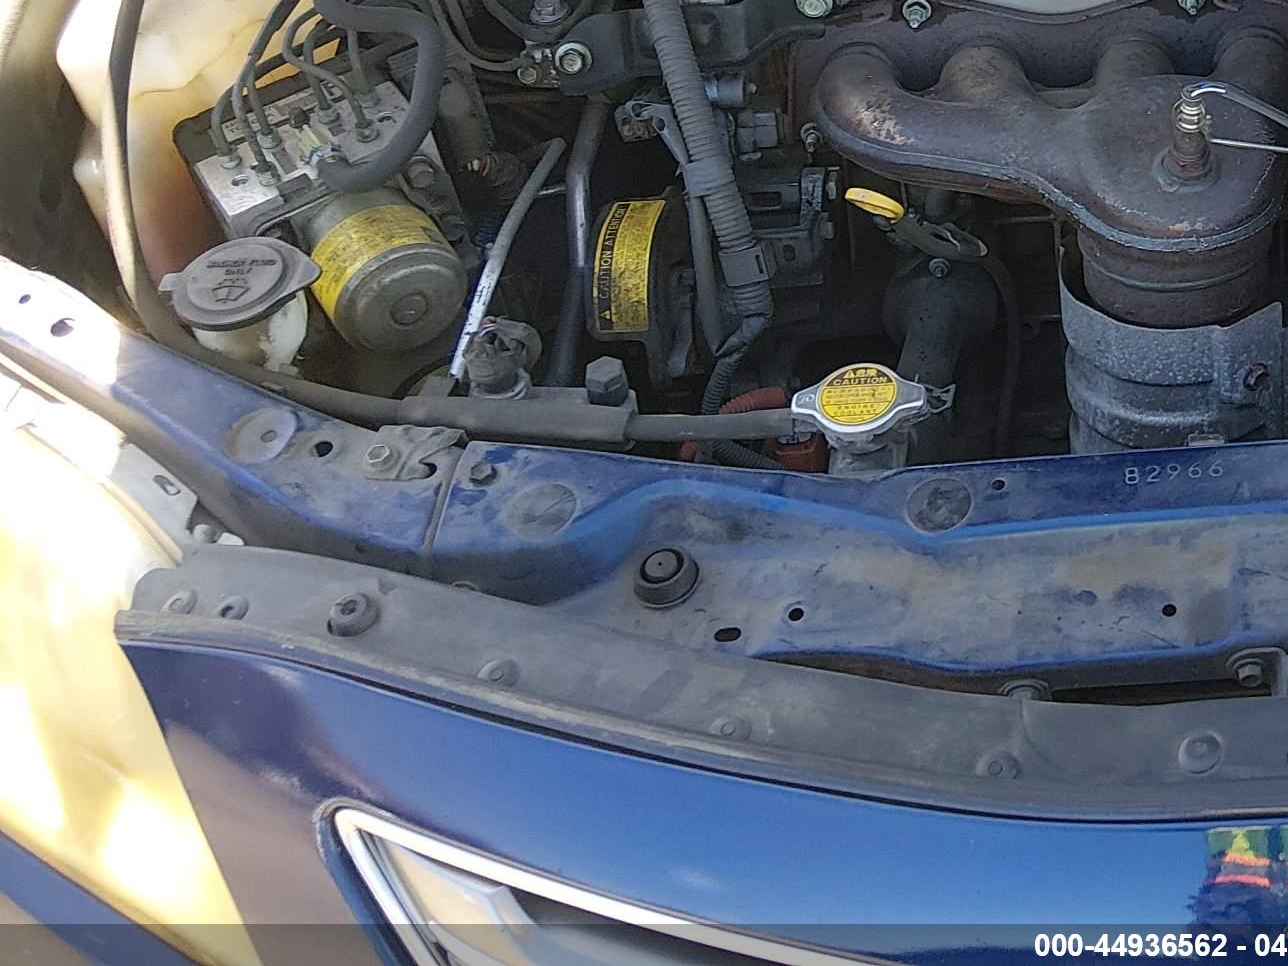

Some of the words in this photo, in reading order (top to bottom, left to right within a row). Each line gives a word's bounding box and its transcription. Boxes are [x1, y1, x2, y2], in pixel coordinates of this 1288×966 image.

[600, 249, 613, 299] CAUTION
[833, 376, 888, 385] CAUTION
[1124, 459, 1224, 485] 82966
